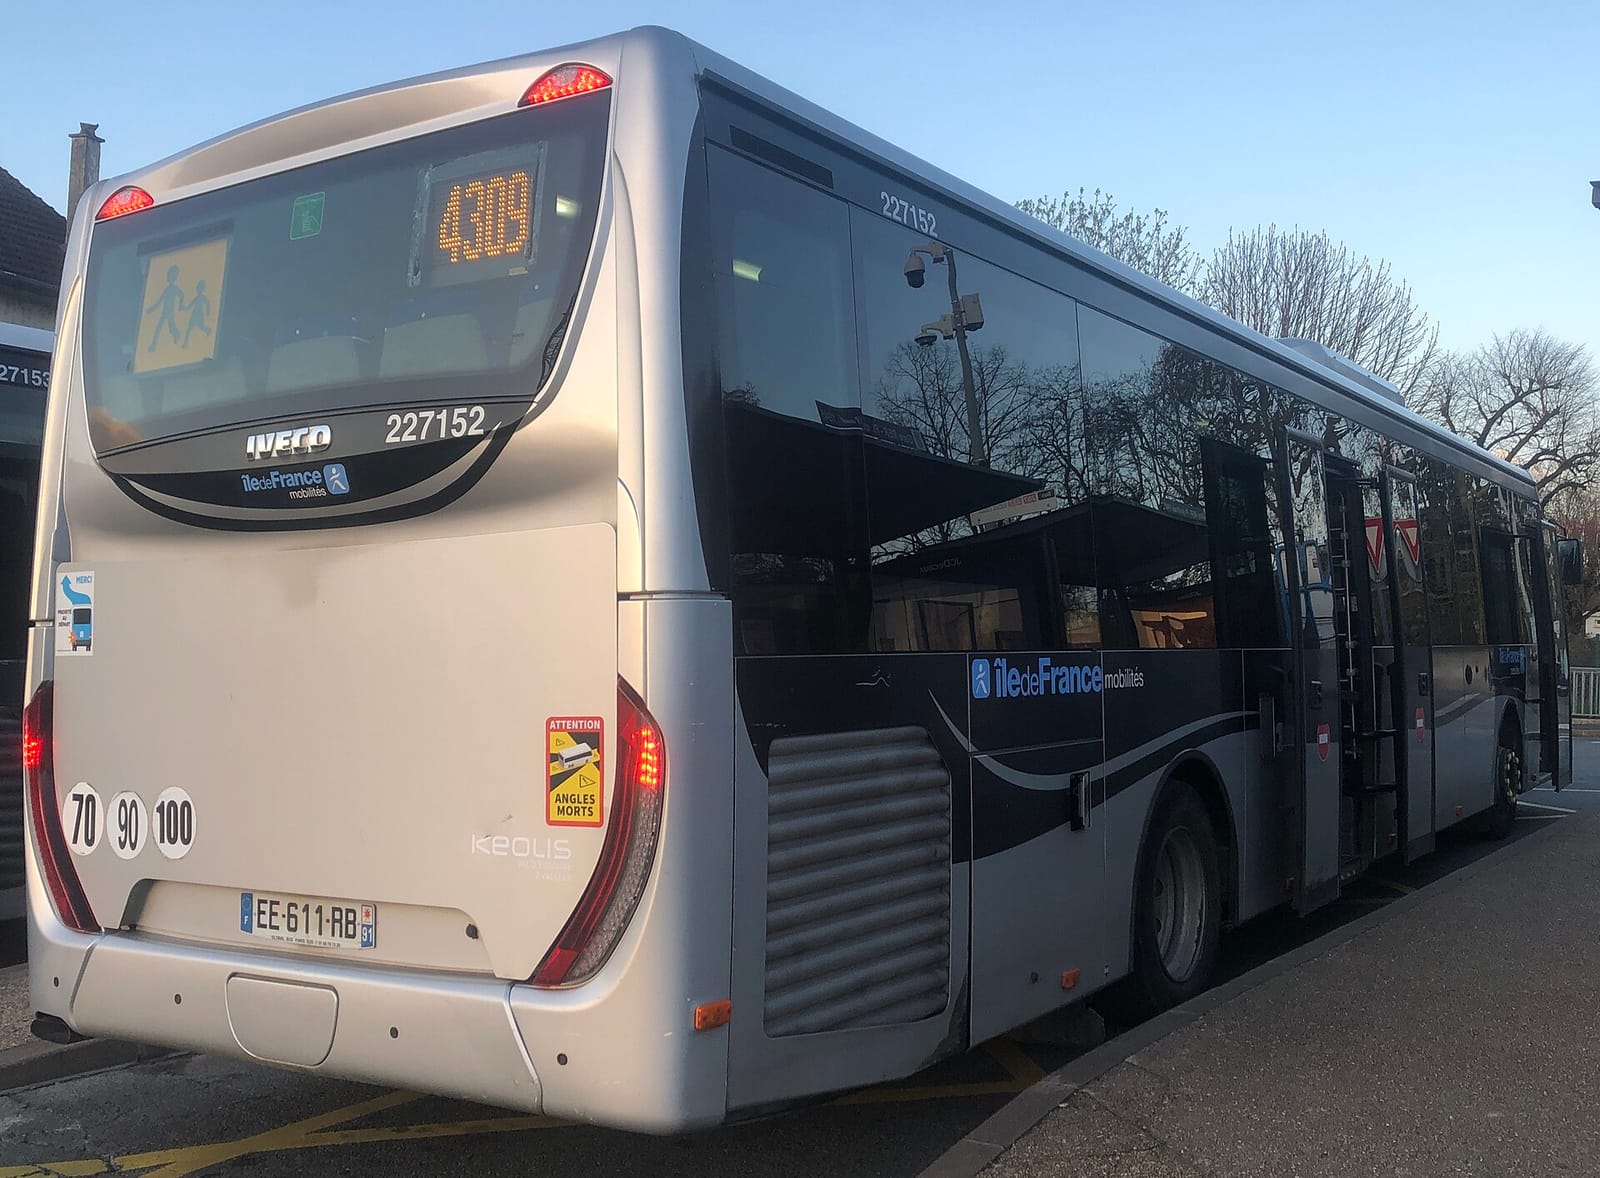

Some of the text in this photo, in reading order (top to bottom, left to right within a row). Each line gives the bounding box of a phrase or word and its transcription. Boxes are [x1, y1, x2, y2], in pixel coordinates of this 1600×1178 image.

[439, 170, 529, 264] 4309
[880, 191, 938, 238] 227152
[246, 424, 332, 460] IVECO
[385, 405, 486, 443] 227152
[288, 485, 327, 500] mobilités
[1104, 666, 1145, 689] mobilités
[549, 719, 601, 730] ATTENTION
[555, 793, 596, 805] ANGLES
[556, 805, 594, 817] MORTS
[72, 793, 97, 847] 70
[118, 798, 139, 851] 90
[156, 799, 193, 846] 100
[244, 915, 249, 925] F
[256, 898, 357, 940] EE-611-RB
[361, 926, 374, 943] 91
